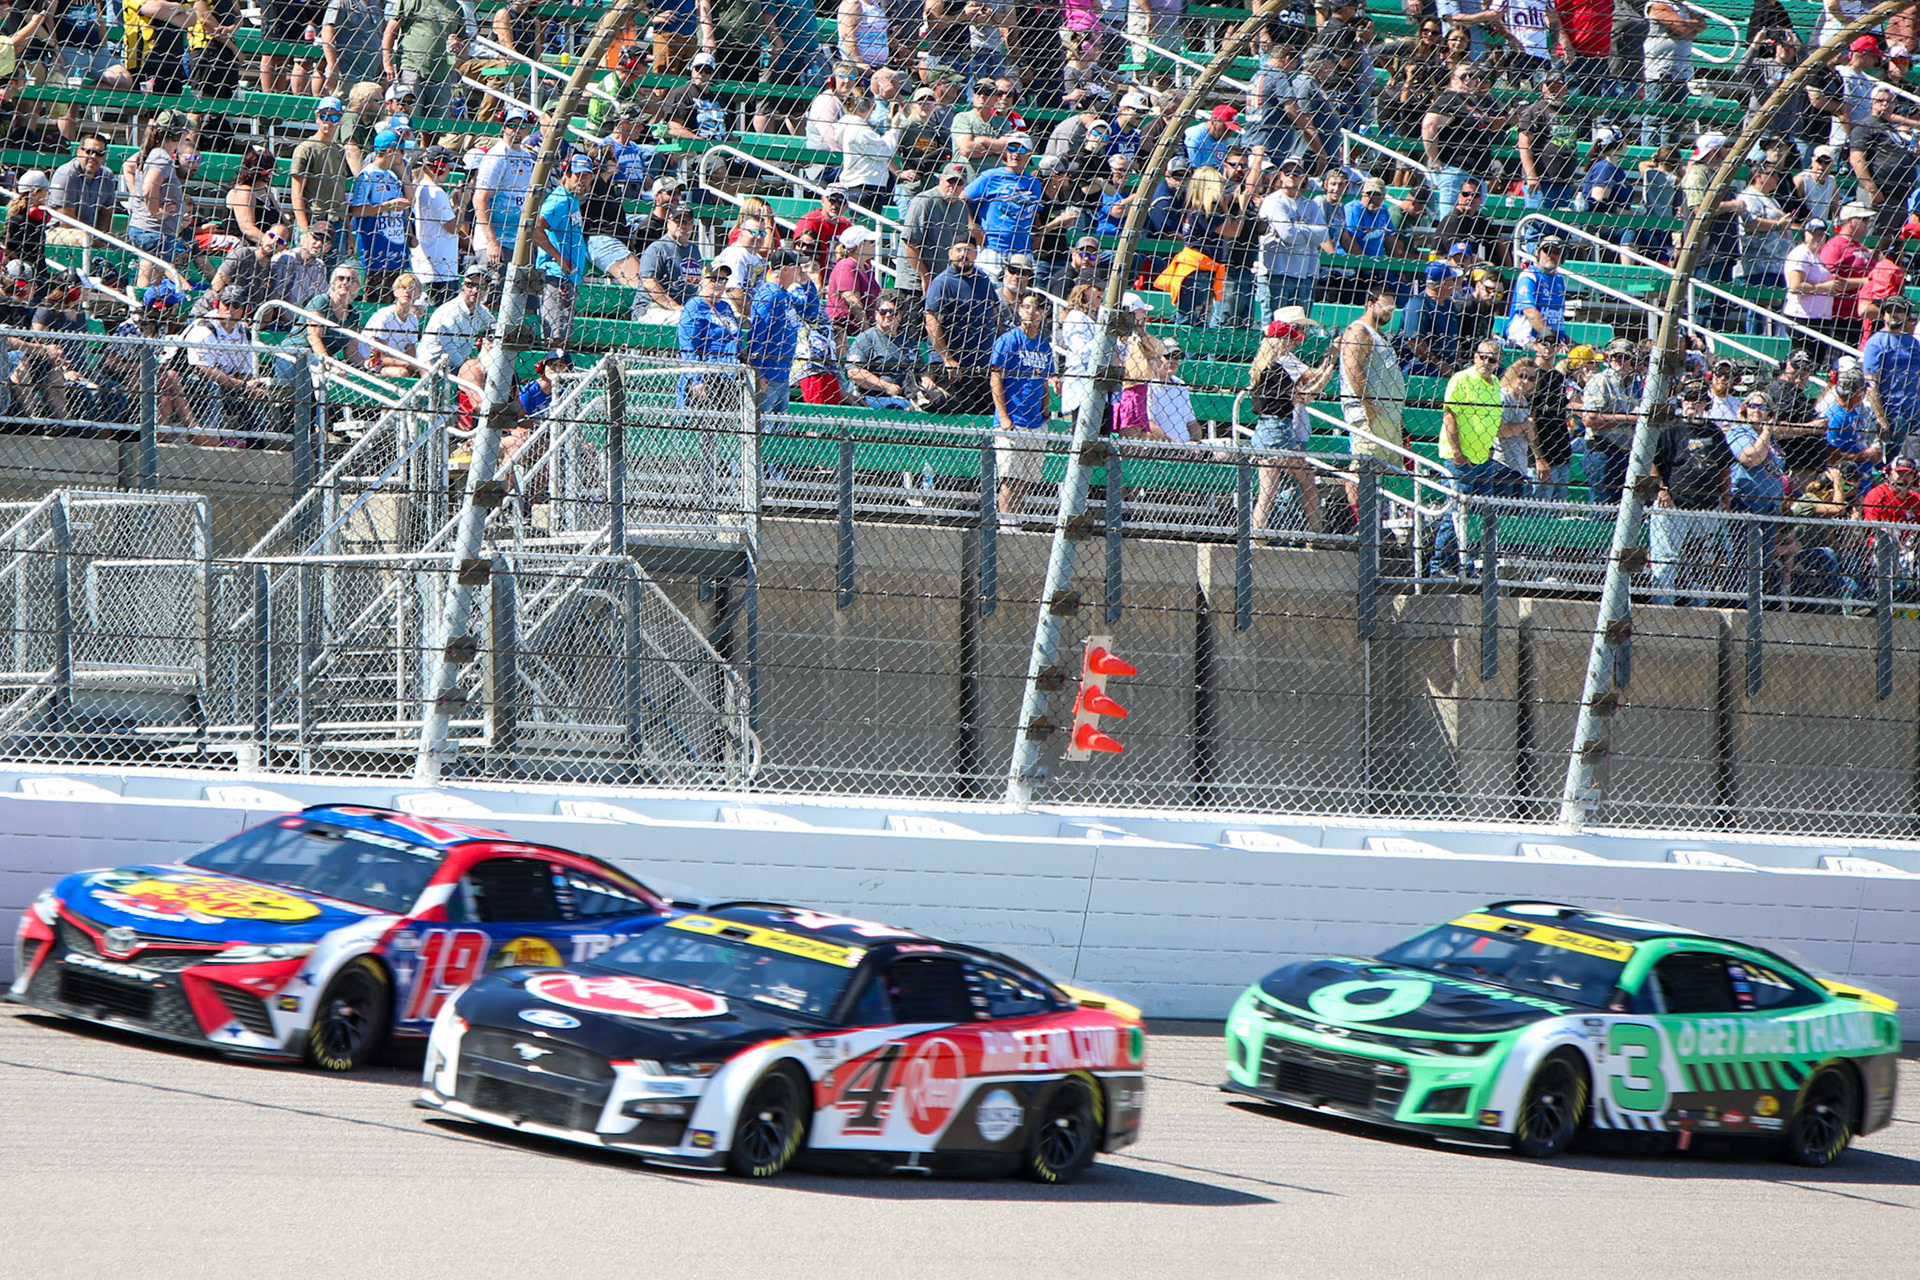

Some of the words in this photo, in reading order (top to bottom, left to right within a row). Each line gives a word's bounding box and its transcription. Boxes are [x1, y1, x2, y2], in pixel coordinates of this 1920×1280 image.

[402, 930, 492, 1022] 19
[767, 934, 851, 961] HARVIC
[1554, 933, 1622, 954] DILLON
[840, 1041, 906, 1136] 4
[1606, 1021, 1669, 1112] 3
